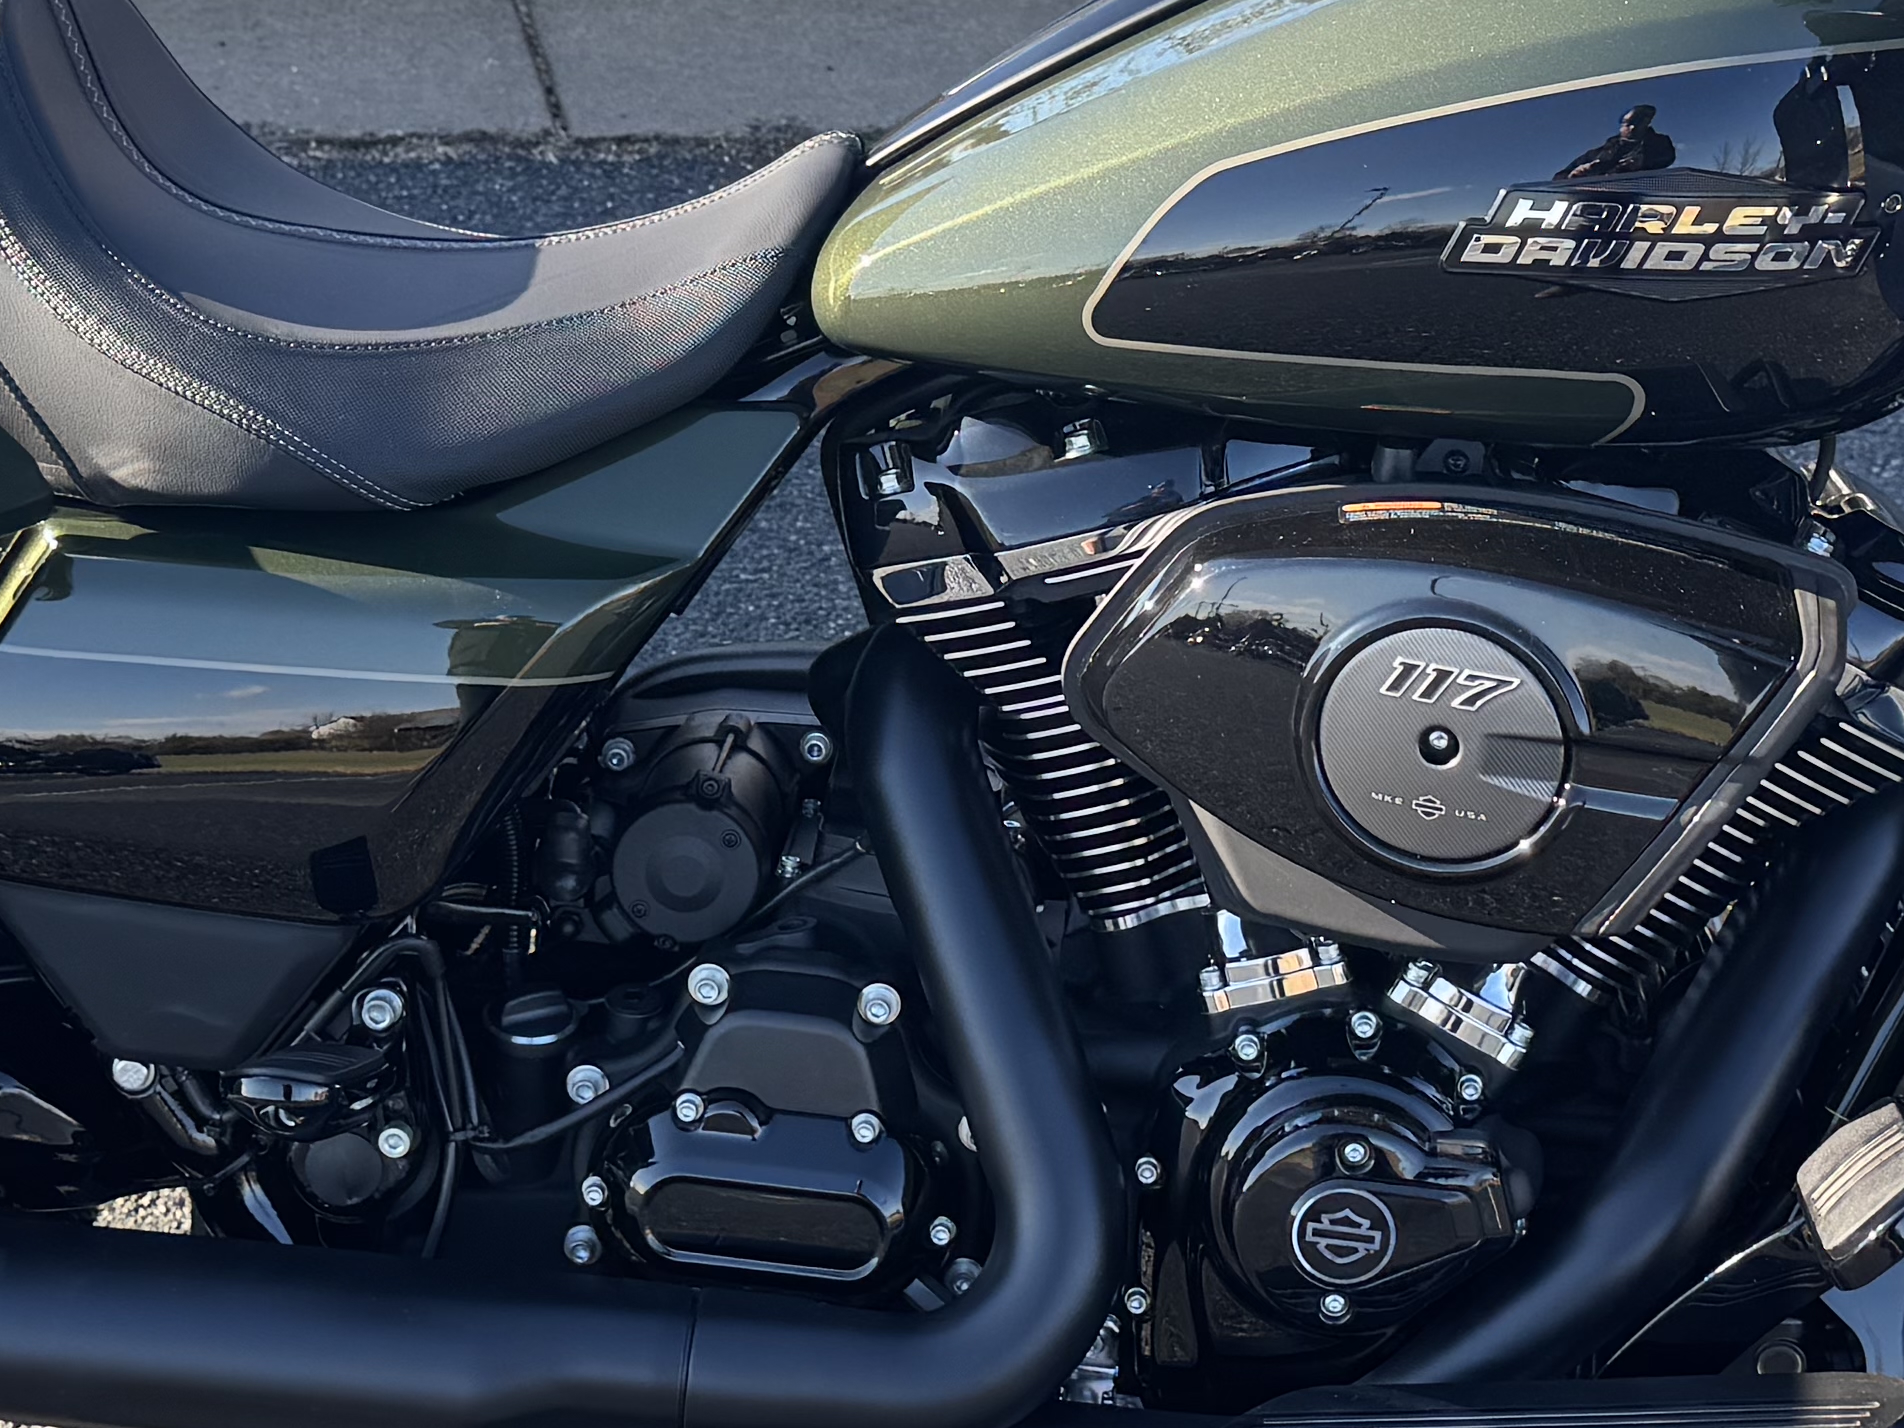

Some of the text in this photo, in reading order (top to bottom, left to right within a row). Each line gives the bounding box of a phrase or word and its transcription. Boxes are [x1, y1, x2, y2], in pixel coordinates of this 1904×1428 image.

[1505, 198, 1848, 236] HARLEY-
[1460, 233, 1865, 272] DAVIDSON
[1379, 656, 1522, 712] 117
[1371, 791, 1488, 822] MKE USA
